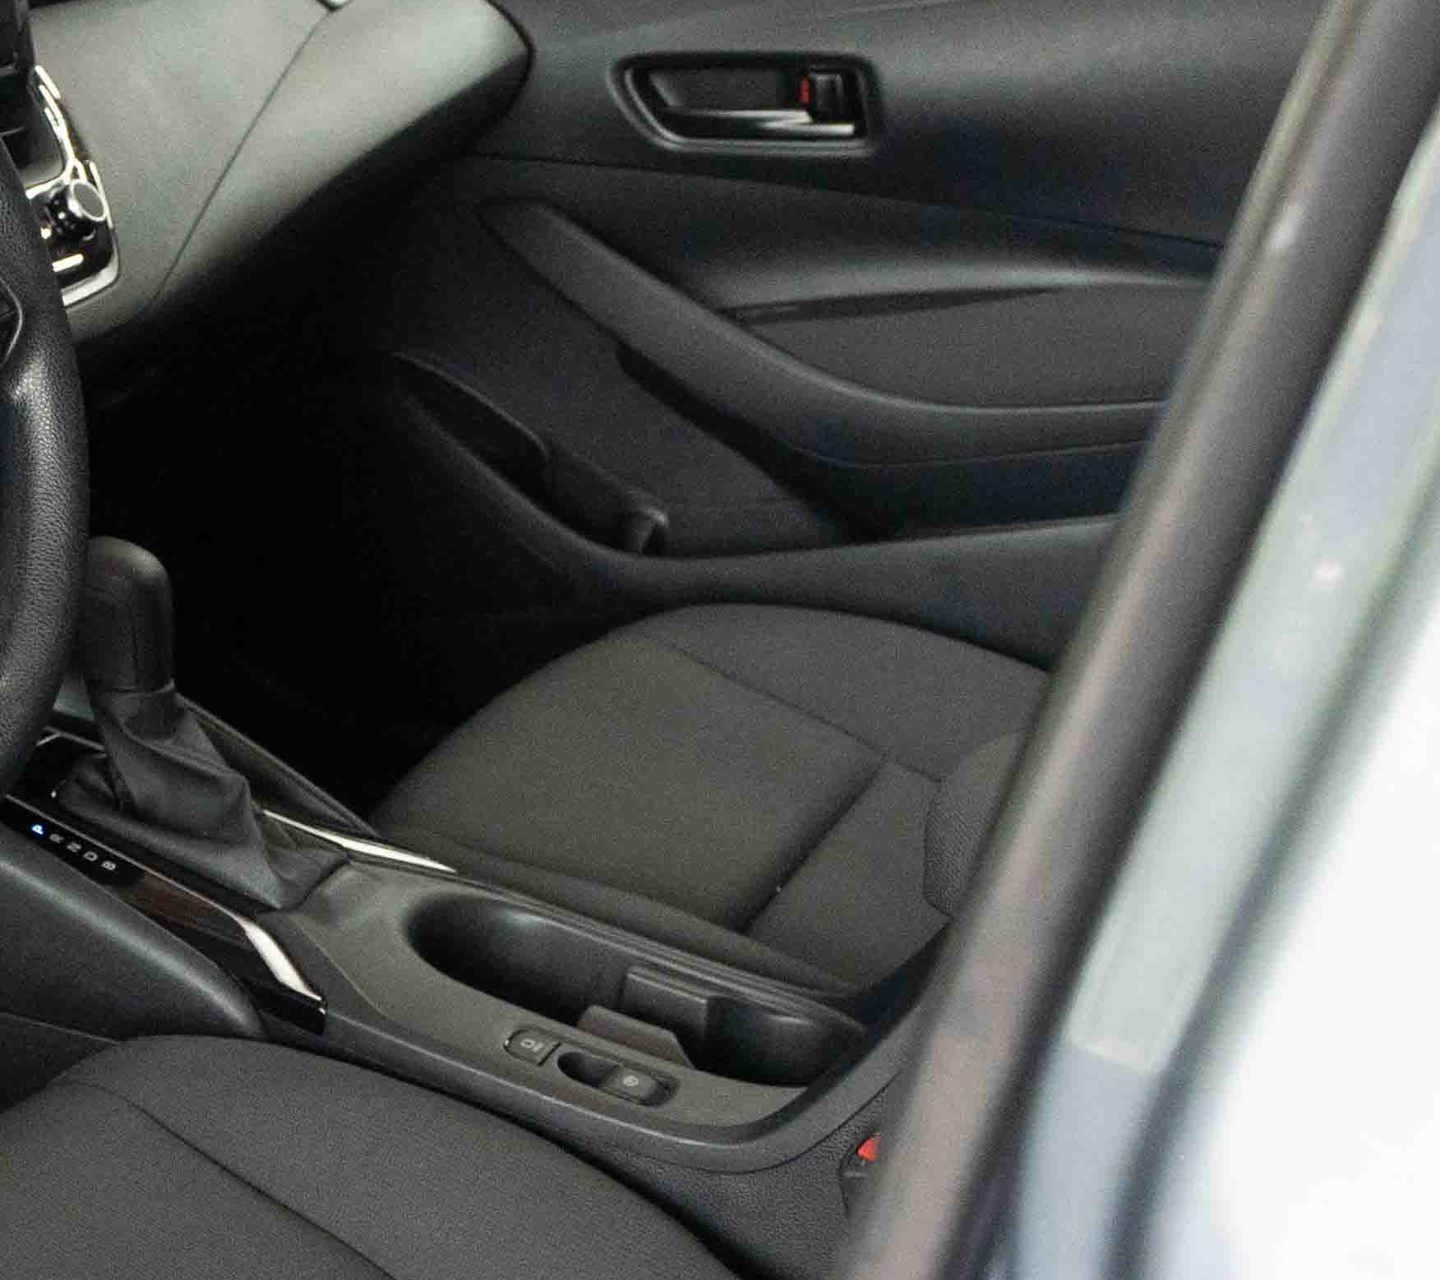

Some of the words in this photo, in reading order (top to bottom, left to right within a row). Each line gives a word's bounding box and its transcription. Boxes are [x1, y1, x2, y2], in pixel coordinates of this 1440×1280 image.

[31, 824, 44, 835] P
[83, 851, 98, 862] D
[101, 860, 117, 871] B
